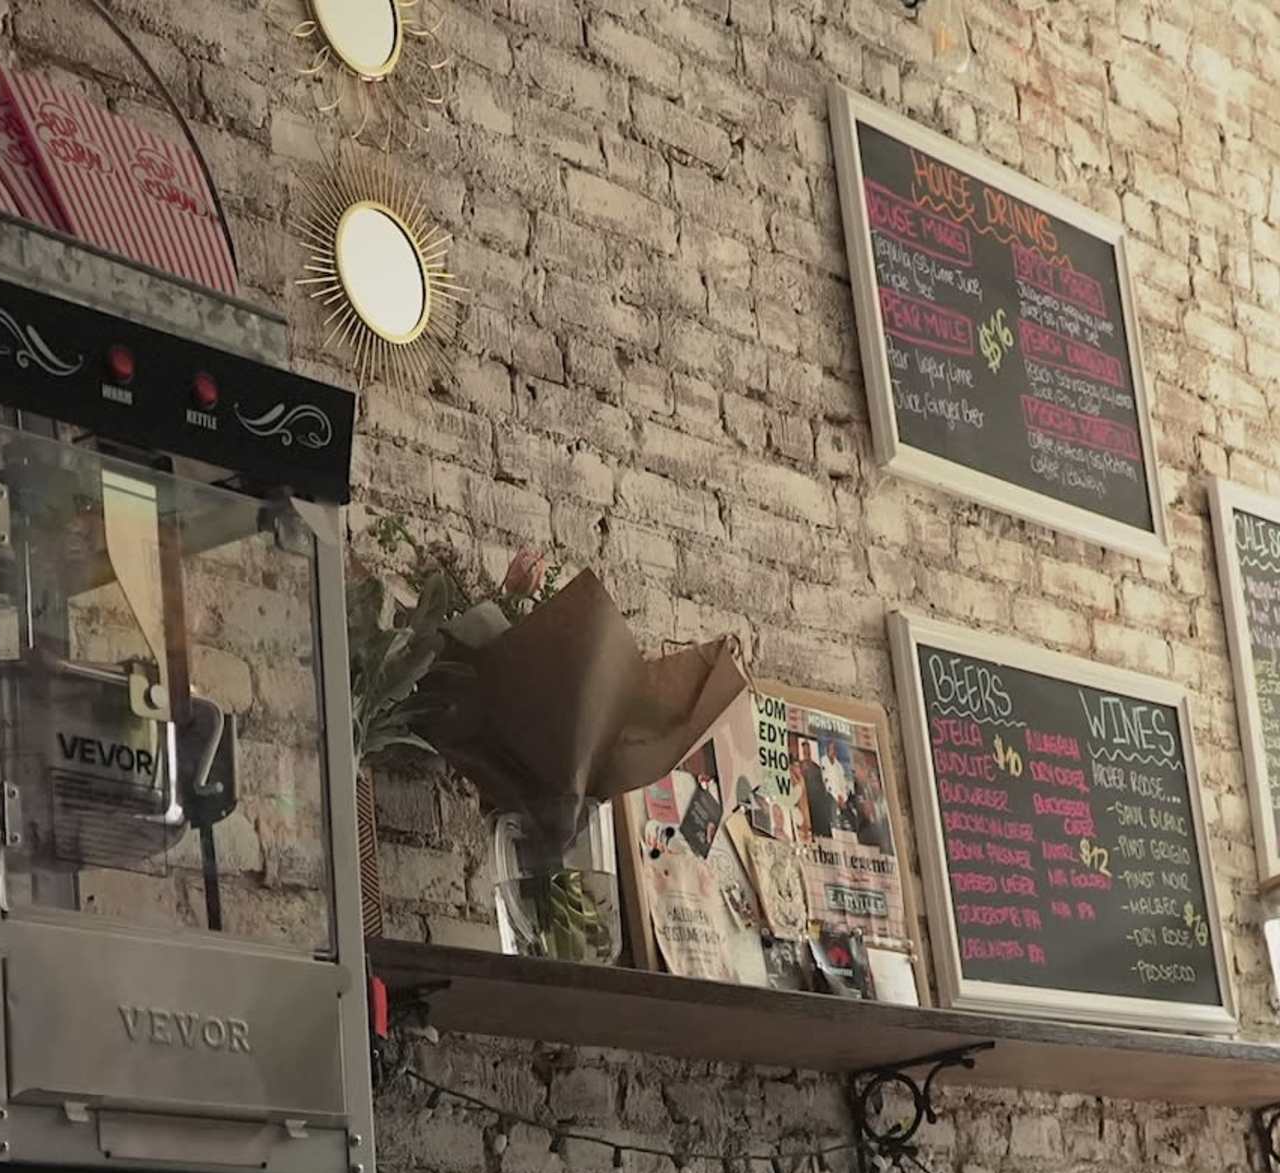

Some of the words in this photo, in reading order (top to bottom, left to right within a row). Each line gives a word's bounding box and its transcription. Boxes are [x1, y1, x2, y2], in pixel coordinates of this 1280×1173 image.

[909, 146, 975, 213] HOUSE
[983, 186, 1058, 253] DRINKS
[101, 383, 134, 406] WARM
[185, 407, 218, 431] KETTLE
[928, 654, 1013, 717] BEERS
[758, 719, 787, 747] EDY
[932, 716, 984, 748] STELLA
[1078, 689, 1176, 758] WINES
[55, 730, 154, 777] VEVOR
[758, 745, 790, 772] SHO
[992, 733, 1024, 777] $10
[775, 774, 792, 797] W
[1079, 836, 1113, 878] $12
[1160, 870, 1193, 894] NOIR
[116, 1002, 253, 1055] VEVOR
